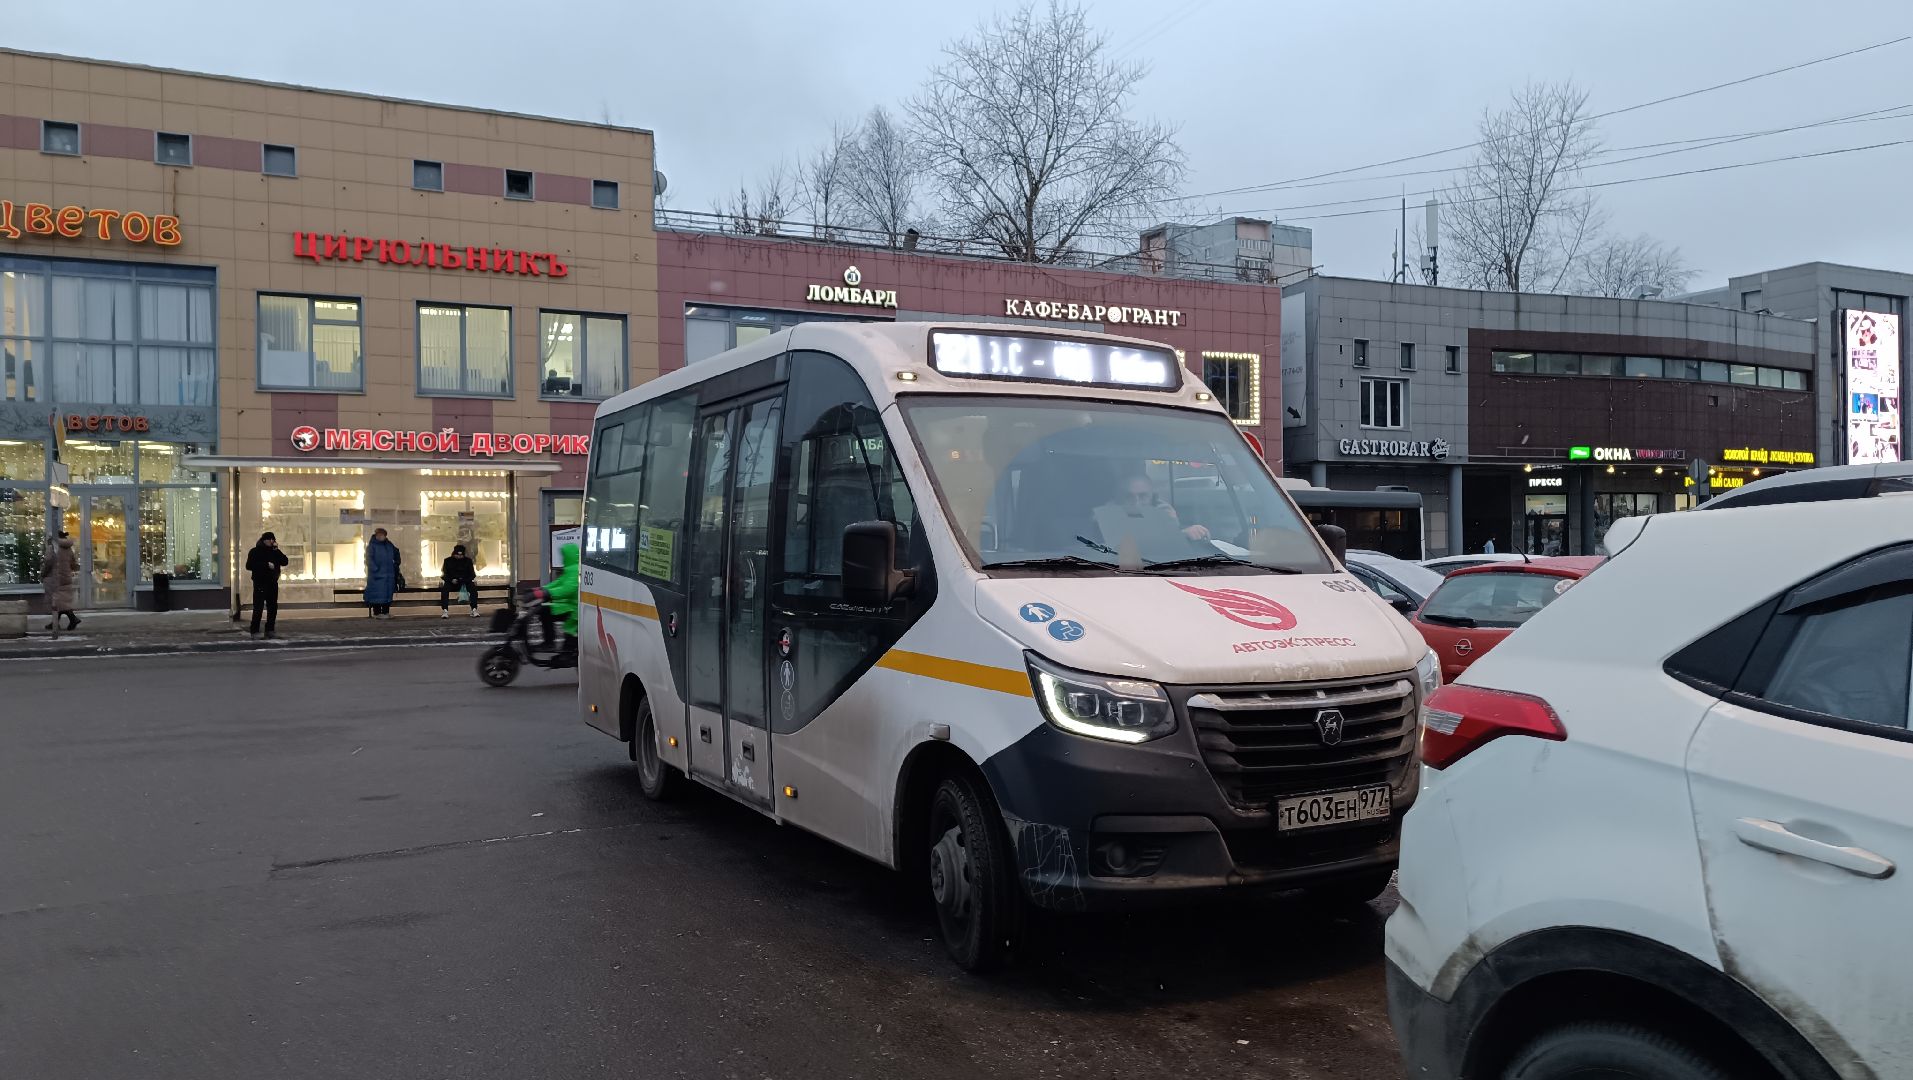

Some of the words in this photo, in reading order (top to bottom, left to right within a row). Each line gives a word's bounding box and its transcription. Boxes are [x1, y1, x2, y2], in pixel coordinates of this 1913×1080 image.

[293, 231, 568, 278] ЦИРЮЛЬНИКЪ
[806, 284, 898, 308] ЛОМБАРД
[324, 428, 460, 453] МЯСНОЙ
[469, 432, 589, 457] ДВОРИК
[1339, 438, 1431, 457] GASTROBAR
[1593, 447, 1632, 461] ОКНА
[1529, 477, 1563, 487] ПРЕССА
[1232, 636, 1357, 654] АВТОЭКСПРЕСС
[1284, 796, 1357, 826] Т603ЕН
[1360, 788, 1386, 809] 977
